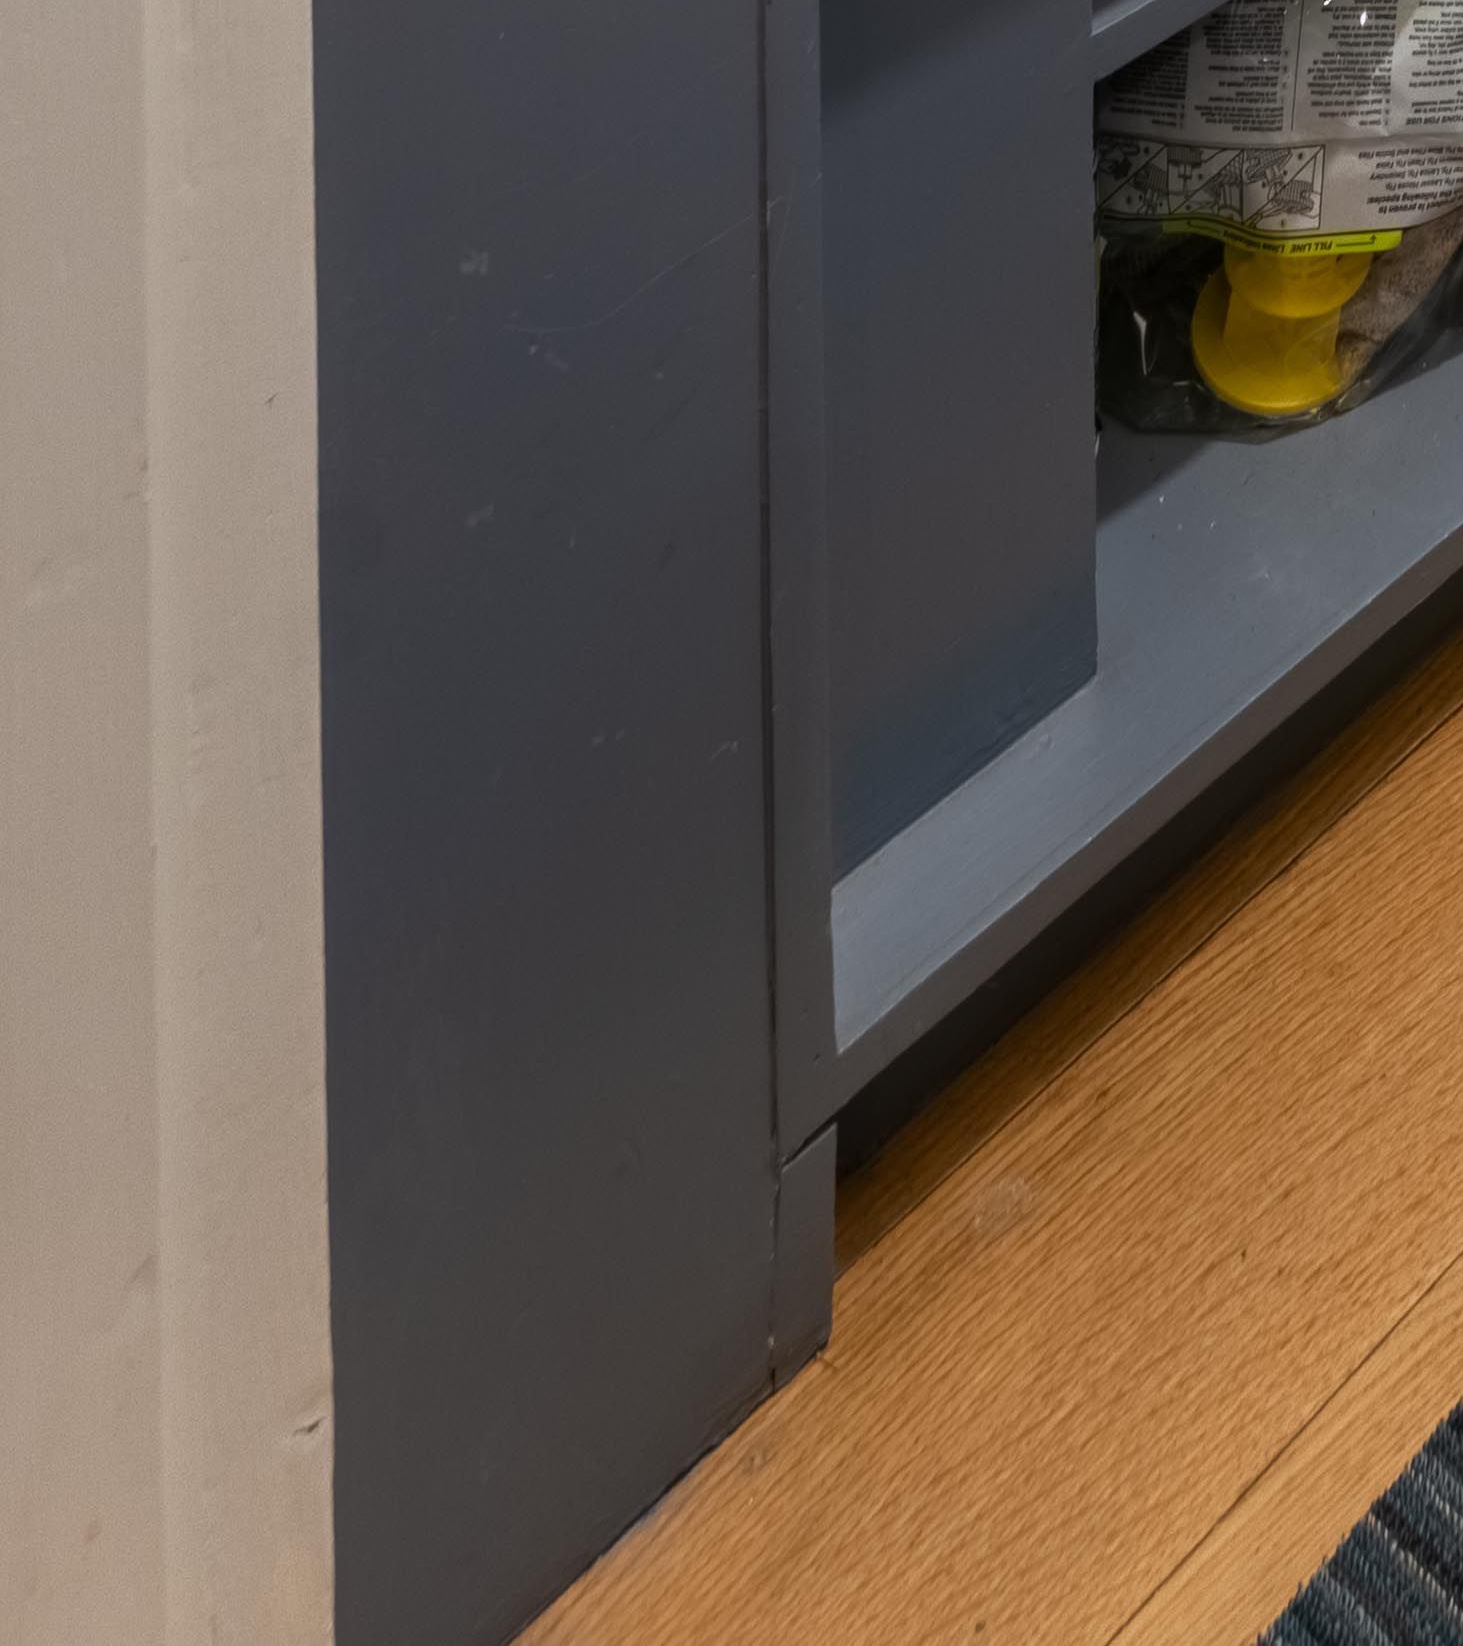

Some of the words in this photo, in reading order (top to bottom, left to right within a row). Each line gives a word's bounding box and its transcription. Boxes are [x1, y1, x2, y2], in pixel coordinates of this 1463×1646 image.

[1405, 116, 1422, 126] USE
[1423, 115, 1441, 125] FOR
[1402, 191, 1438, 203] following
[1289, 240, 1311, 251] LINE
[1311, 239, 1333, 251] FILL
